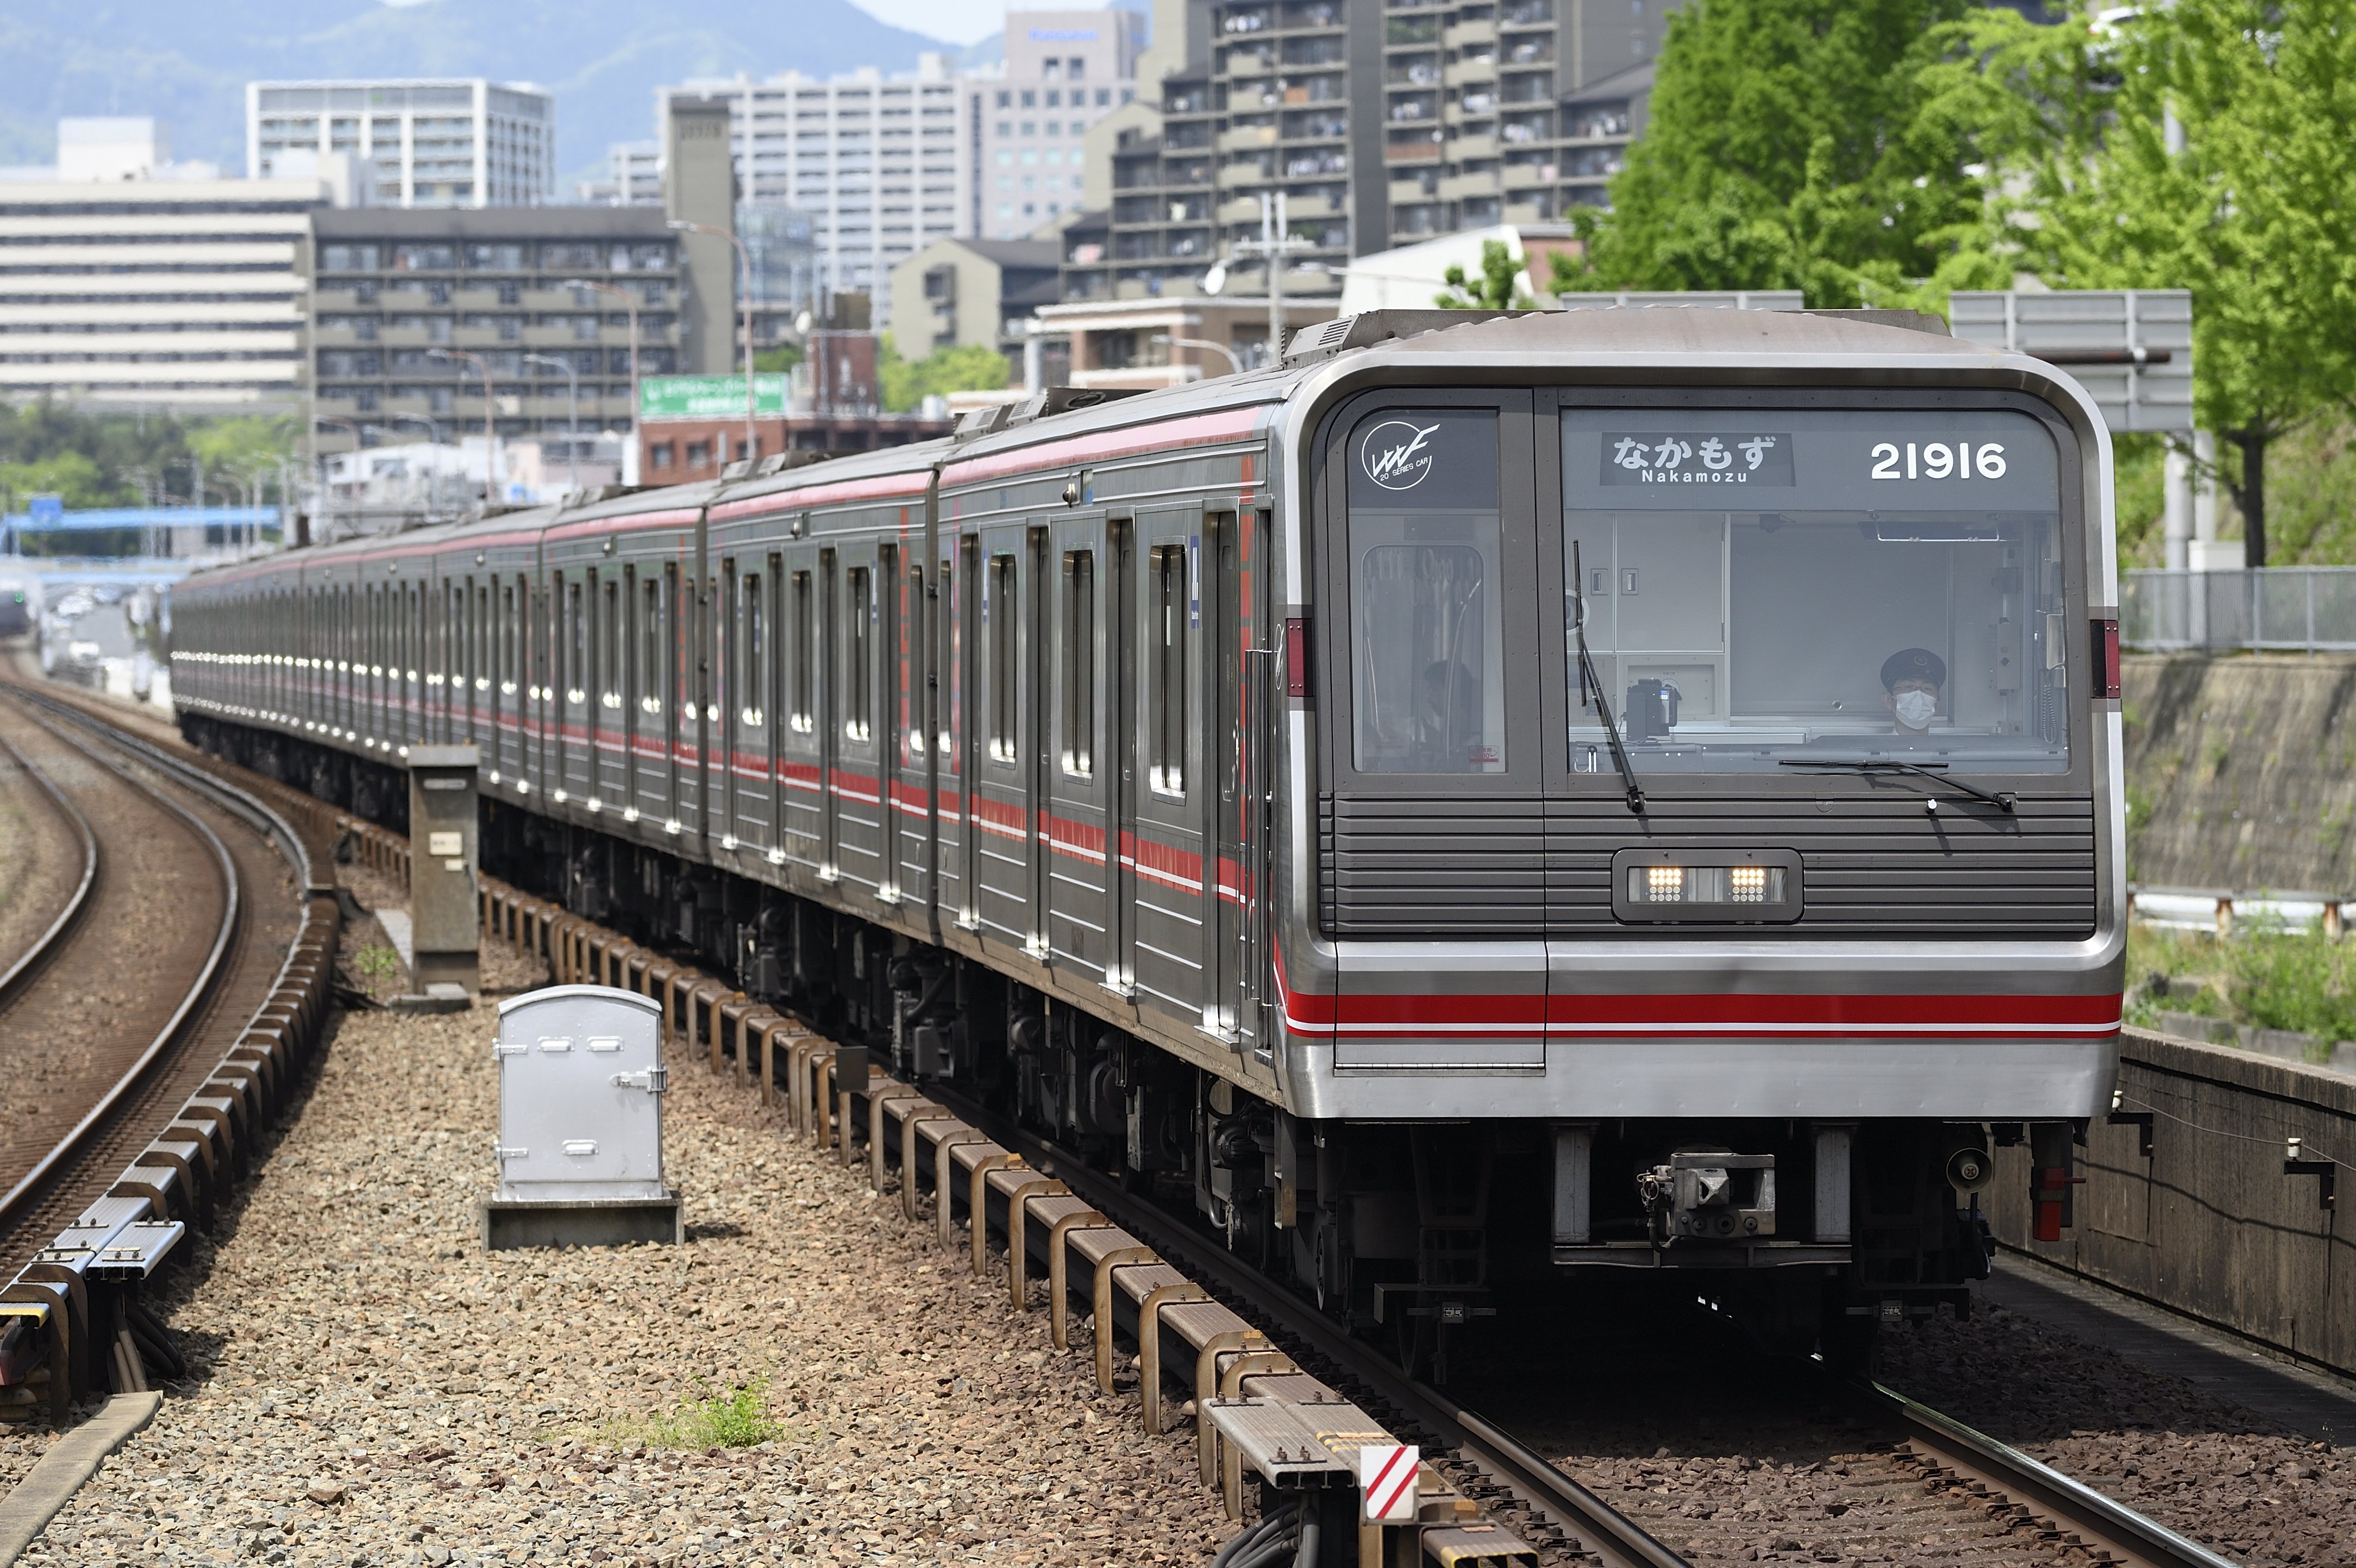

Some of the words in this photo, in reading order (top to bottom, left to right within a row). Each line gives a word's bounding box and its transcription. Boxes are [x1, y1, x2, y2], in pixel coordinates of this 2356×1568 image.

[1614, 436, 1776, 470] なかもず
[1871, 442, 2006, 479] 21916
[1380, 473, 1389, 481] 20
[1392, 463, 1414, 476] SERIES
[1416, 457, 1428, 467] CAR
[1642, 469, 1746, 482] Nakamozu
